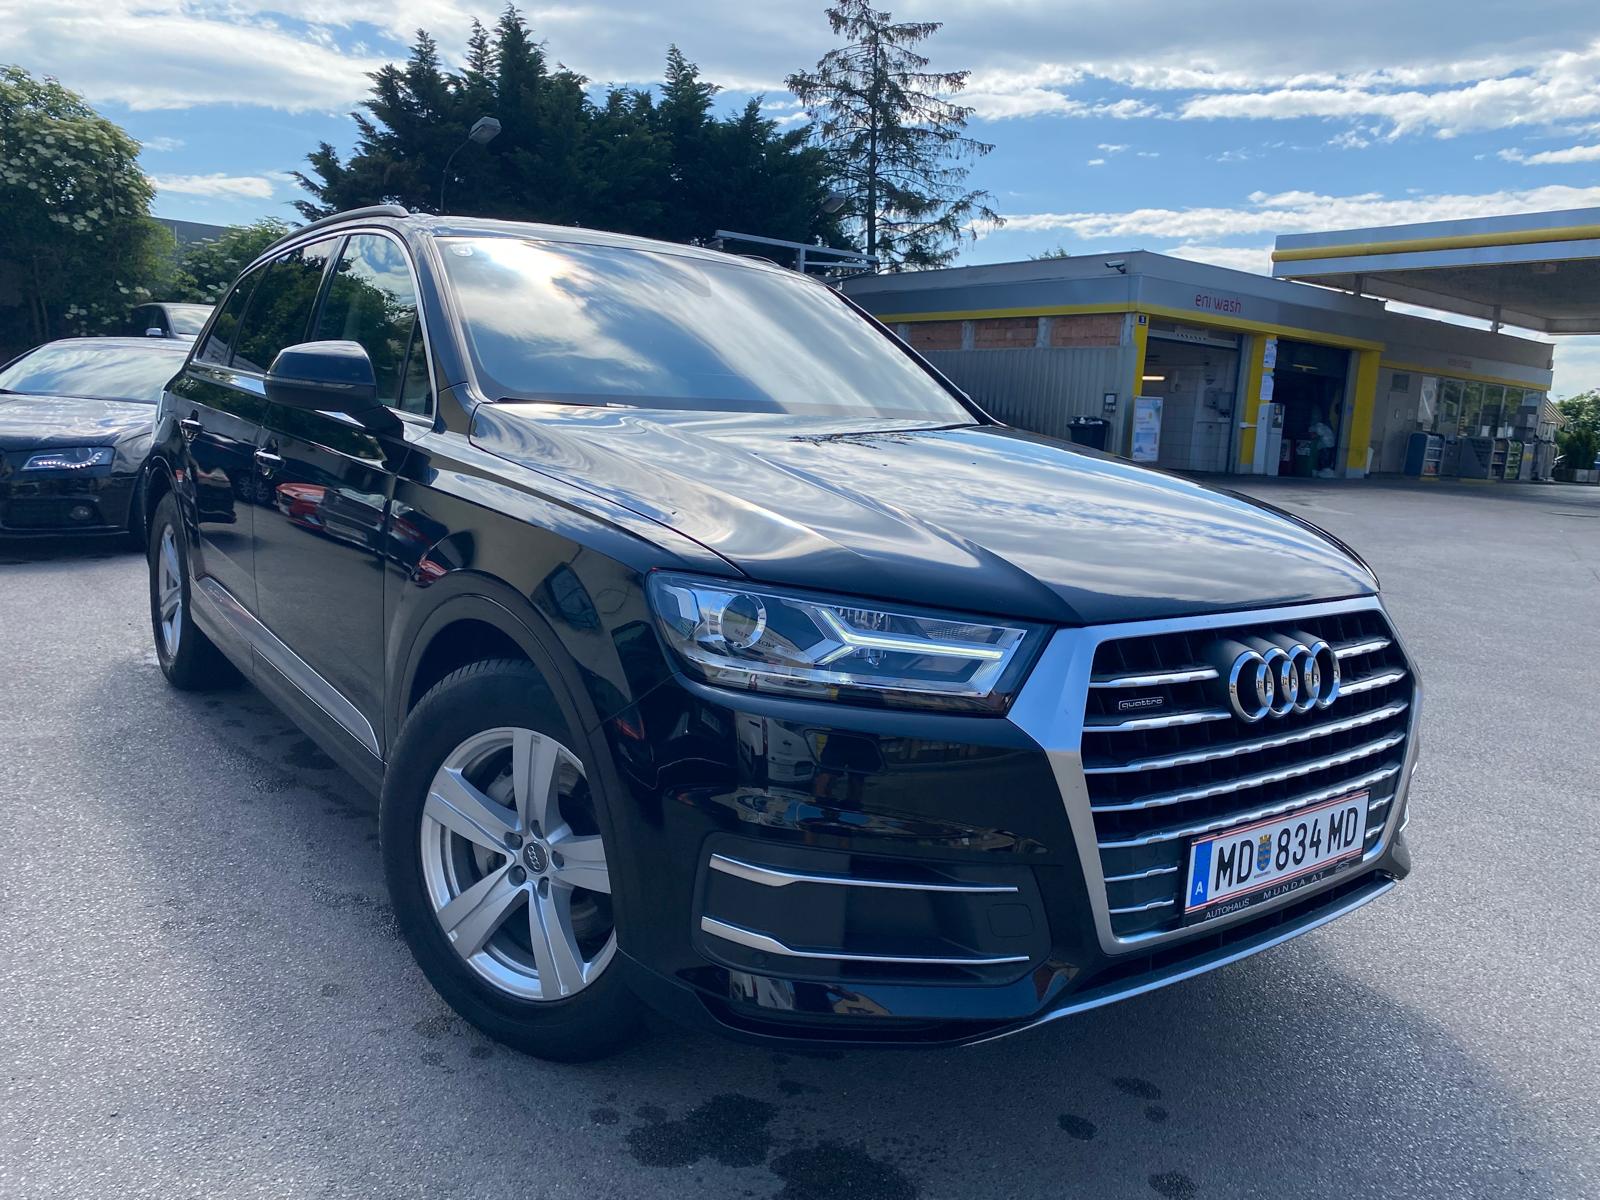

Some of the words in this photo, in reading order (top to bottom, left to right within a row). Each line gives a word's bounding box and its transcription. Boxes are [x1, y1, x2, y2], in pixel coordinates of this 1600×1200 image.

[1195, 294, 1211, 308] eni
[1214, 296, 1242, 313] wash
[1121, 699, 1163, 709] quattro
[1214, 840, 1254, 891] MD
[1275, 818, 1322, 871] 834
[1326, 806, 1359, 854] MD
[1195, 881, 1203, 895] A
[1205, 898, 1250, 920] AUTOHAUS
